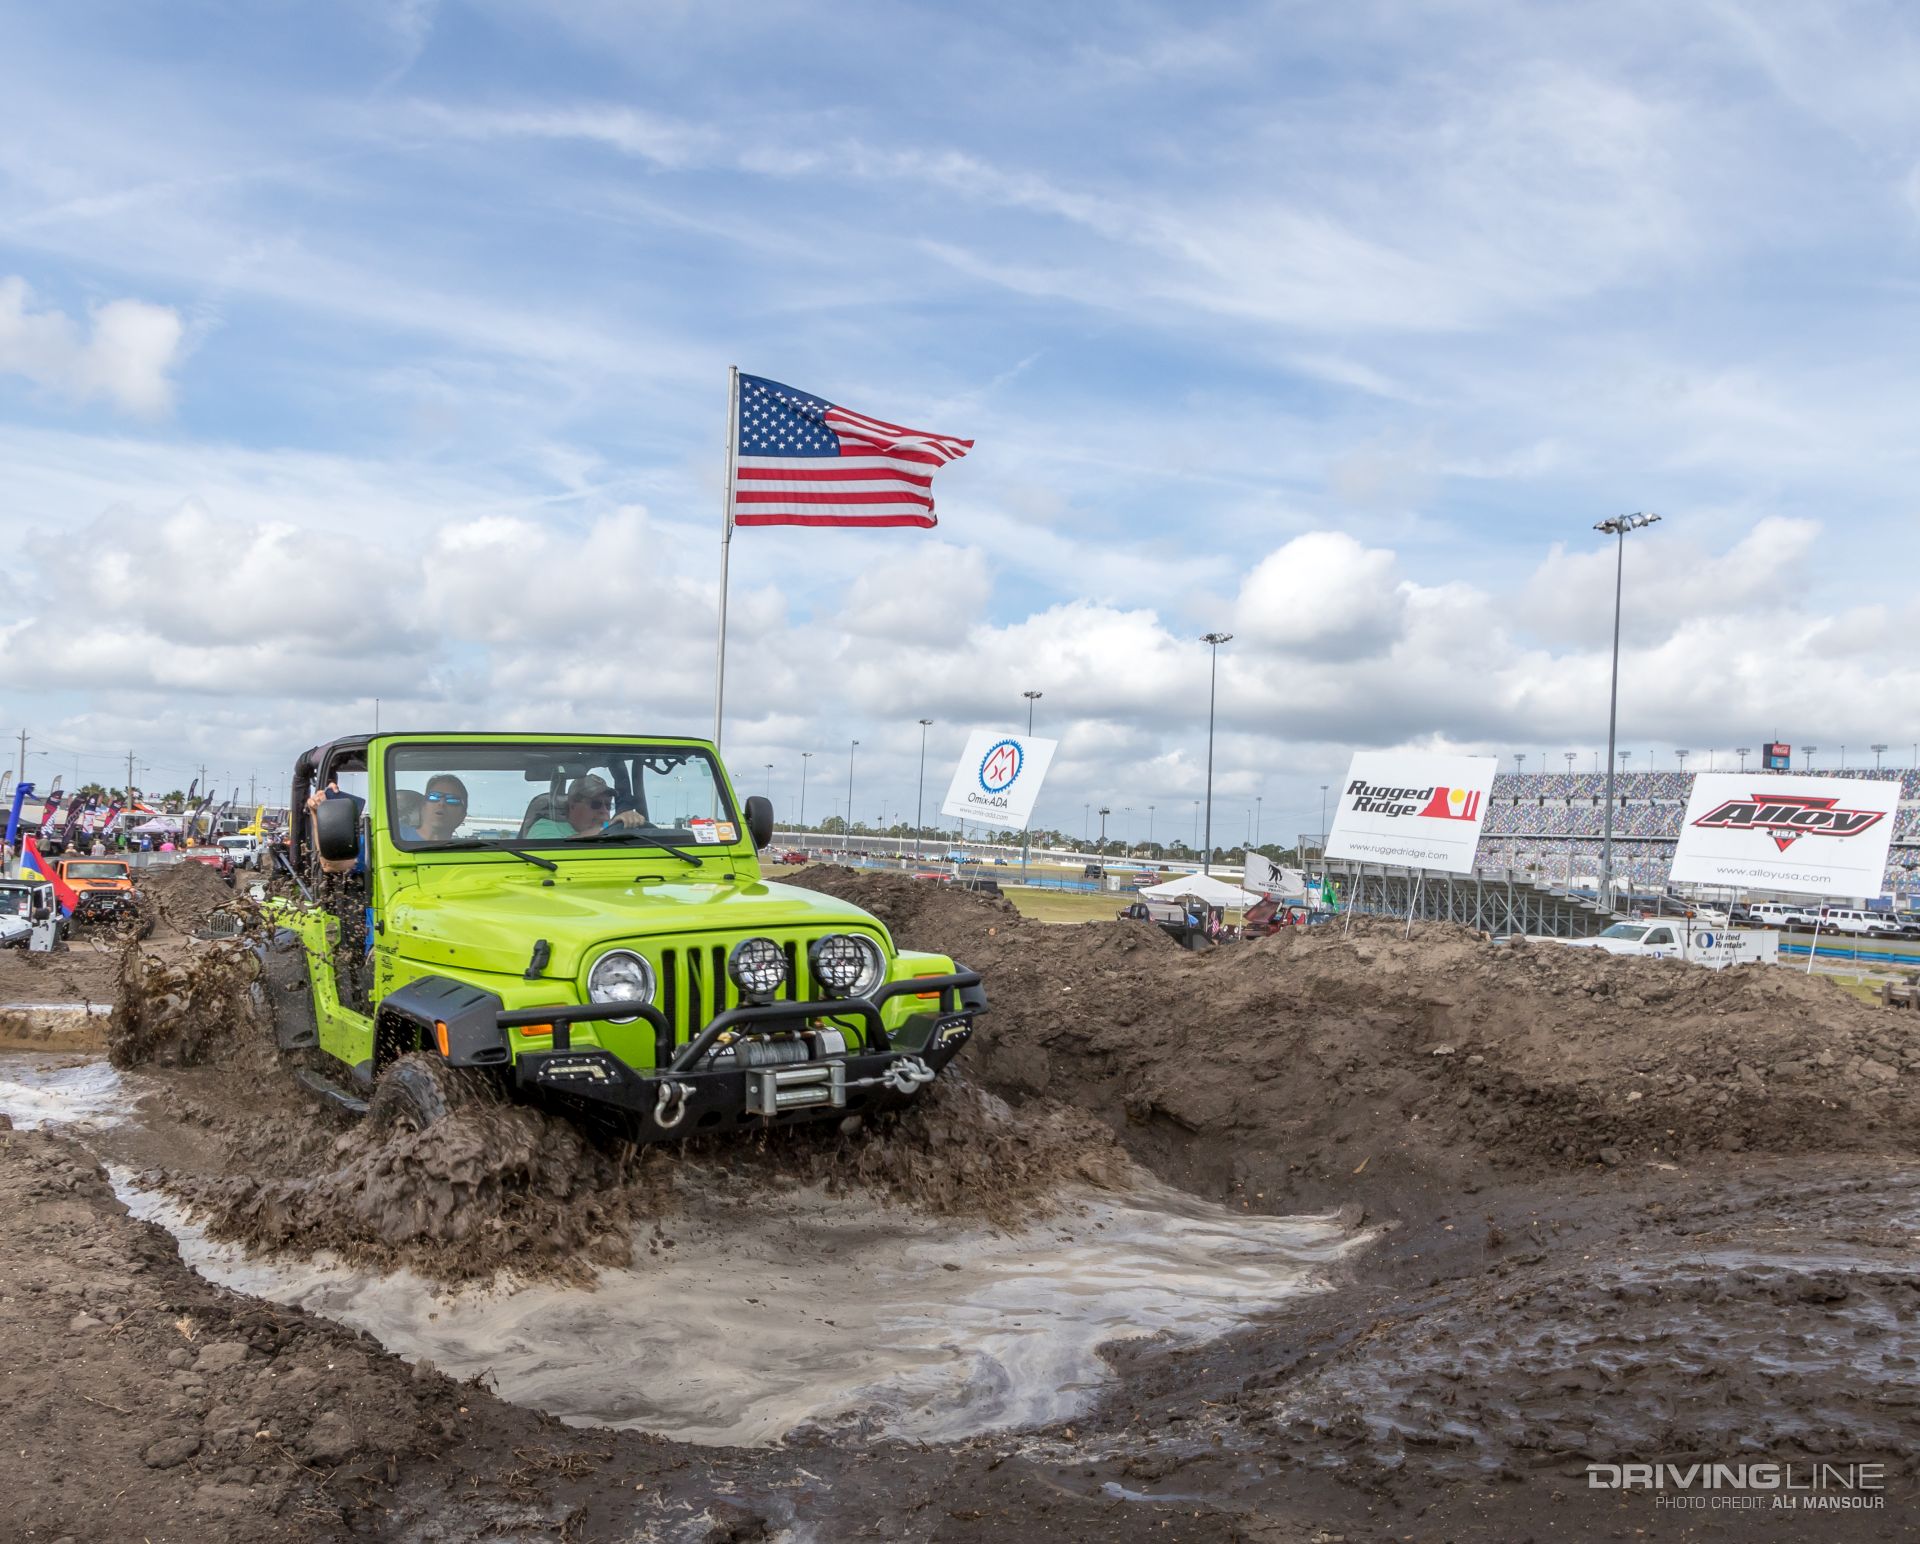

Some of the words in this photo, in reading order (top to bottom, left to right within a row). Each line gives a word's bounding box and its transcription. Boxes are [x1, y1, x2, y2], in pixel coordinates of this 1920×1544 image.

[1346, 780, 1434, 801] Rugged
[967, 792, 1008, 808] Omix-ADA
[1352, 796, 1417, 818] Ridge
[1703, 803, 1874, 830] Alloy
[1772, 829, 1797, 839] USA
[1349, 843, 1448, 861] www.ruggedridge.com
[1716, 867, 1831, 884] www.alloyusa.com
